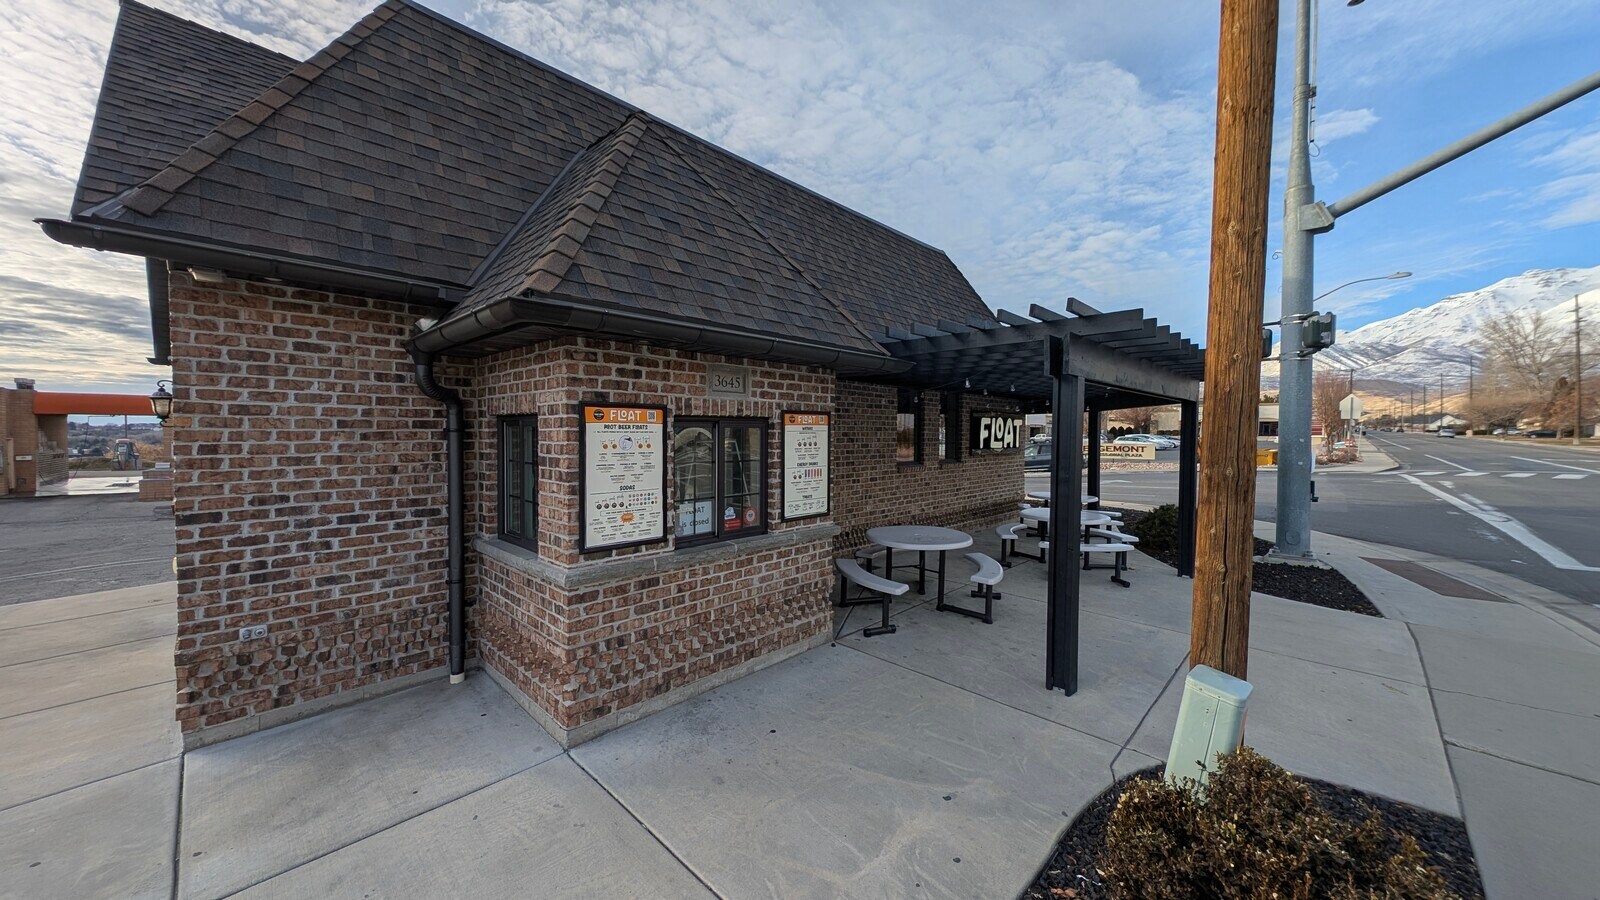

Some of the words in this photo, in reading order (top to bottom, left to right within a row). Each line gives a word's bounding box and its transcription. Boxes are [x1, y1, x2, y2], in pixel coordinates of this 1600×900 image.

[714, 374, 741, 389] 3645
[610, 409, 642, 421] FLOAT
[798, 415, 817, 424] FLOAT
[980, 417, 1023, 449] FLOAT
[1083, 445, 1147, 453] EGEMONT
[689, 517, 710, 527] cosed
